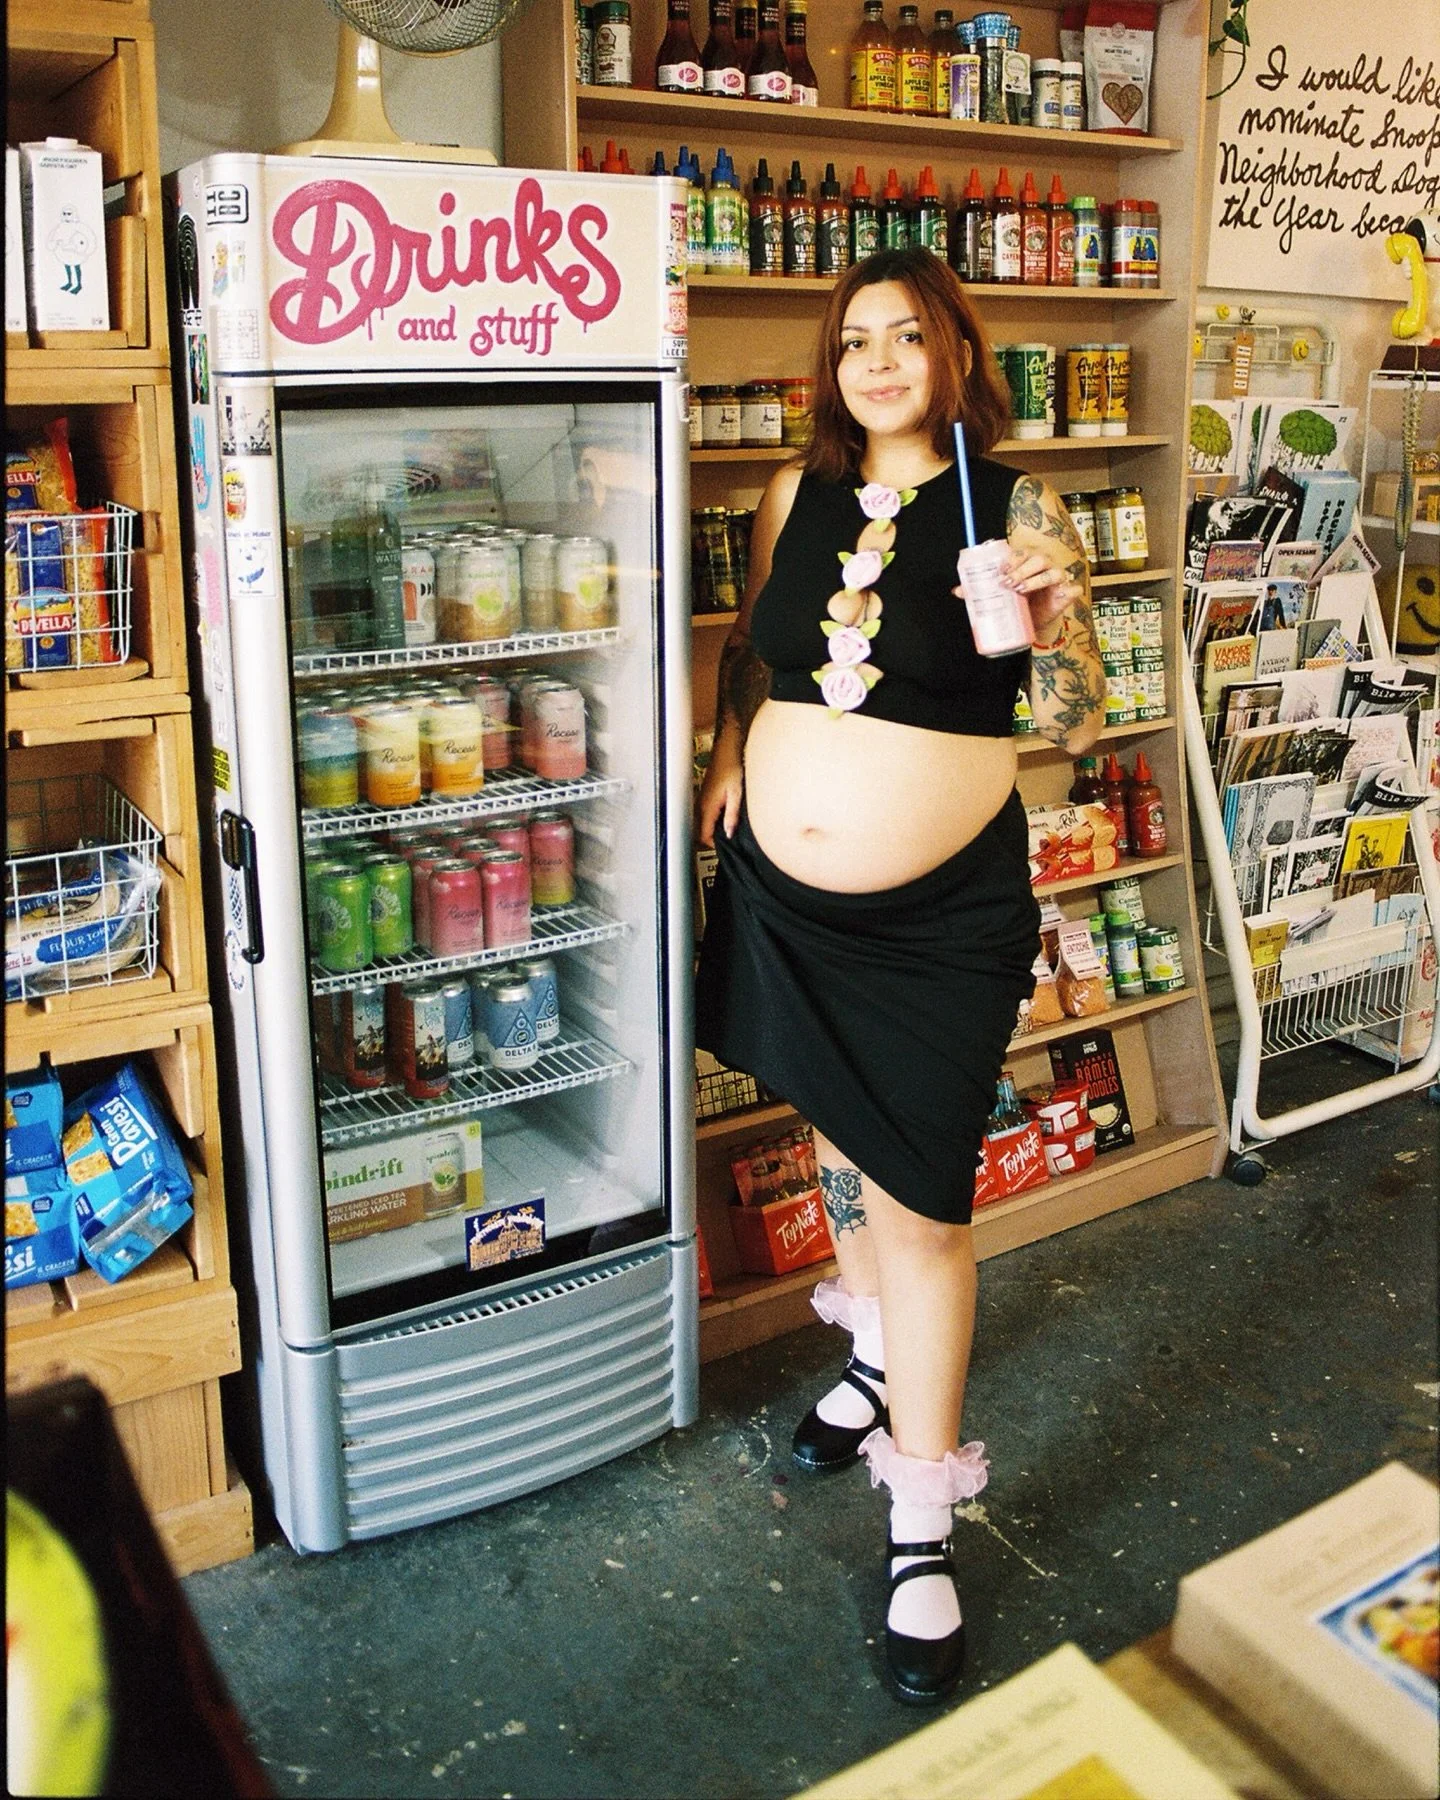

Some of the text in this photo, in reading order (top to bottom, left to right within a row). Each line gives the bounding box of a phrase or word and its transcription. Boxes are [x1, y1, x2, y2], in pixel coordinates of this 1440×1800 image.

[1256, 45, 1288, 91] I
[1299, 53, 1390, 94] would
[1239, 101, 1364, 147] nominate
[1220, 142, 1387, 207] Neighborhood
[1219, 187, 1262, 229] the
[1274, 195, 1344, 254] Year
[269, 178, 621, 344] Drinks
[398, 302, 559, 356] and stuff
[1295, 548, 1317, 556] SESAME
[1351, 534, 1364, 548] OPEN
[1374, 790, 1402, 804] Bile
[504, 1046, 532, 1058] DELTA
[1075, 1059, 1116, 1081] RAMEN
[100, 1096, 150, 1166] Pavesi
[100, 1119, 121, 1146] Gran
[370, 1197, 408, 1214] WATER
